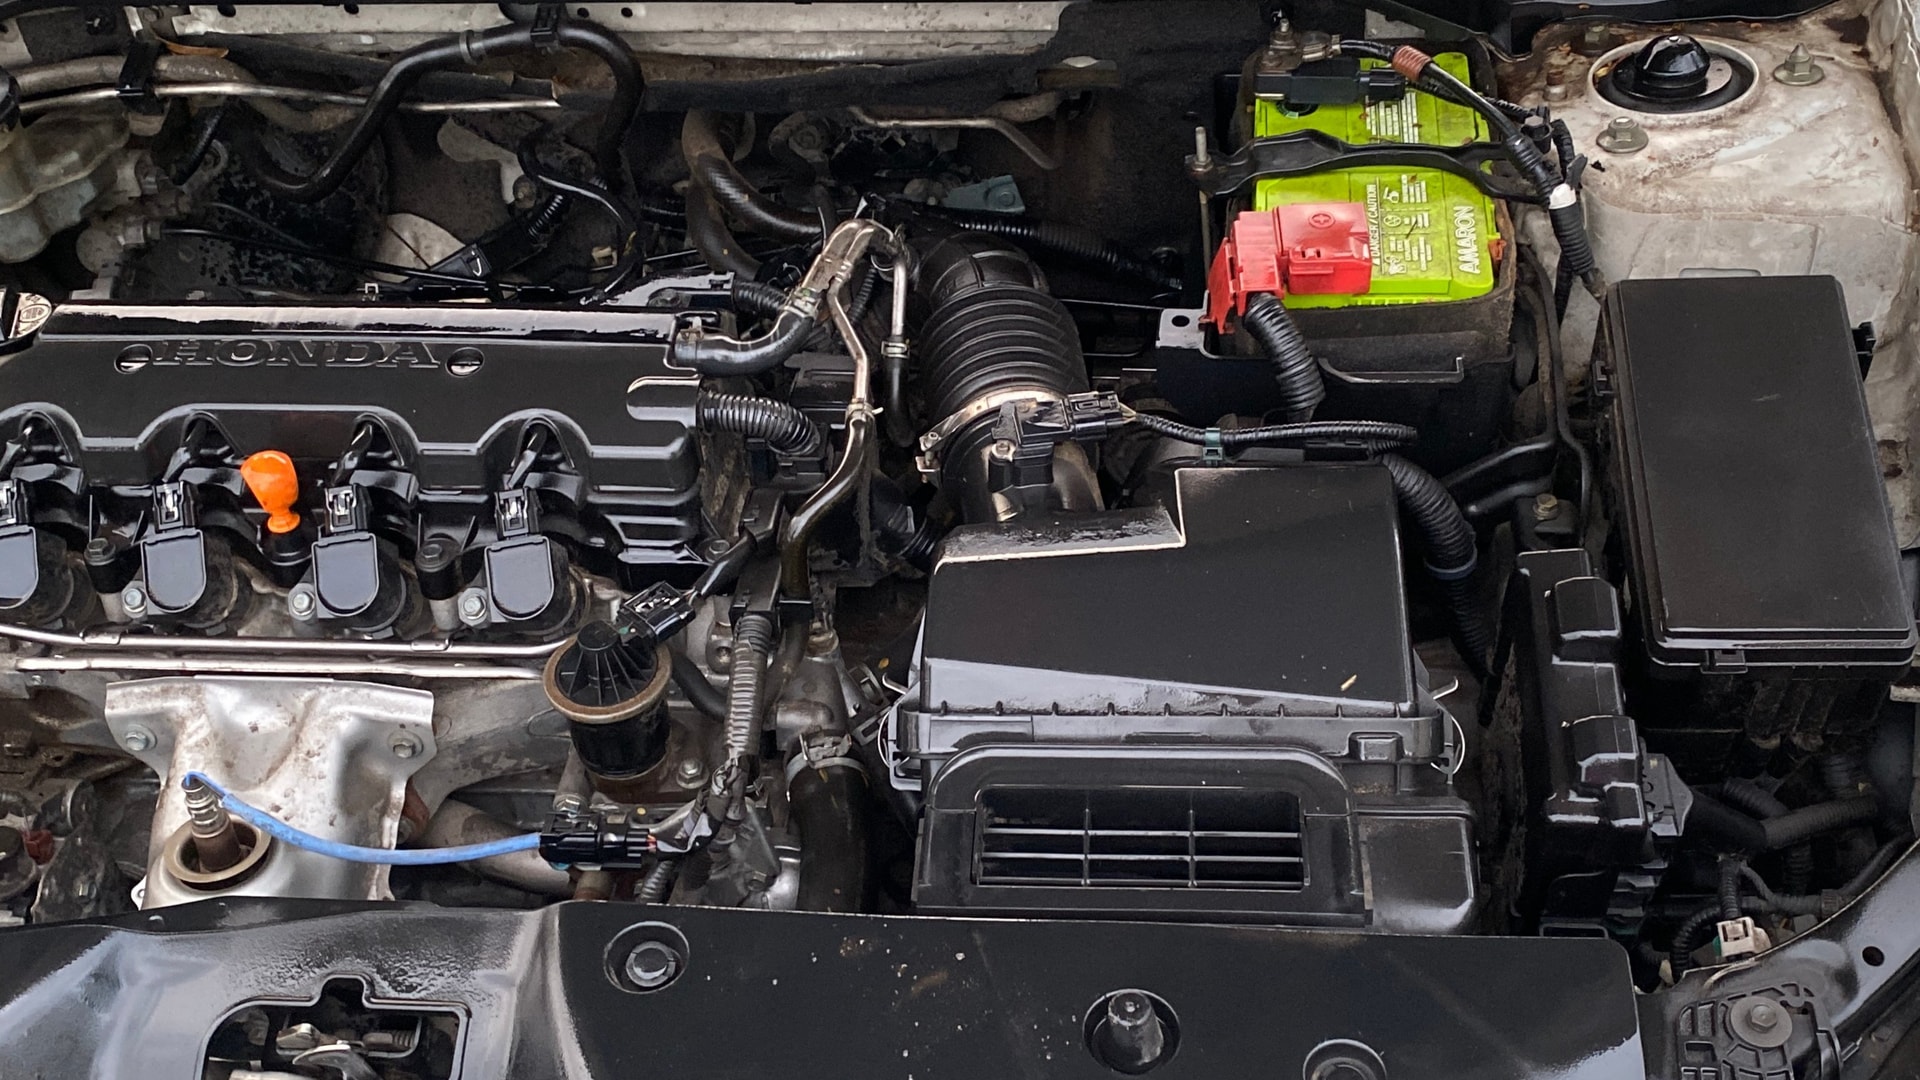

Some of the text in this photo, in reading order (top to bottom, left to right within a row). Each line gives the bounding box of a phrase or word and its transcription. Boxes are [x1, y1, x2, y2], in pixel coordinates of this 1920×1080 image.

[1366, 184, 1379, 218] CAUTION
[1368, 225, 1380, 257] DANGER
[1453, 205, 1481, 274] AMARON
[152, 338, 440, 368] HONDA
